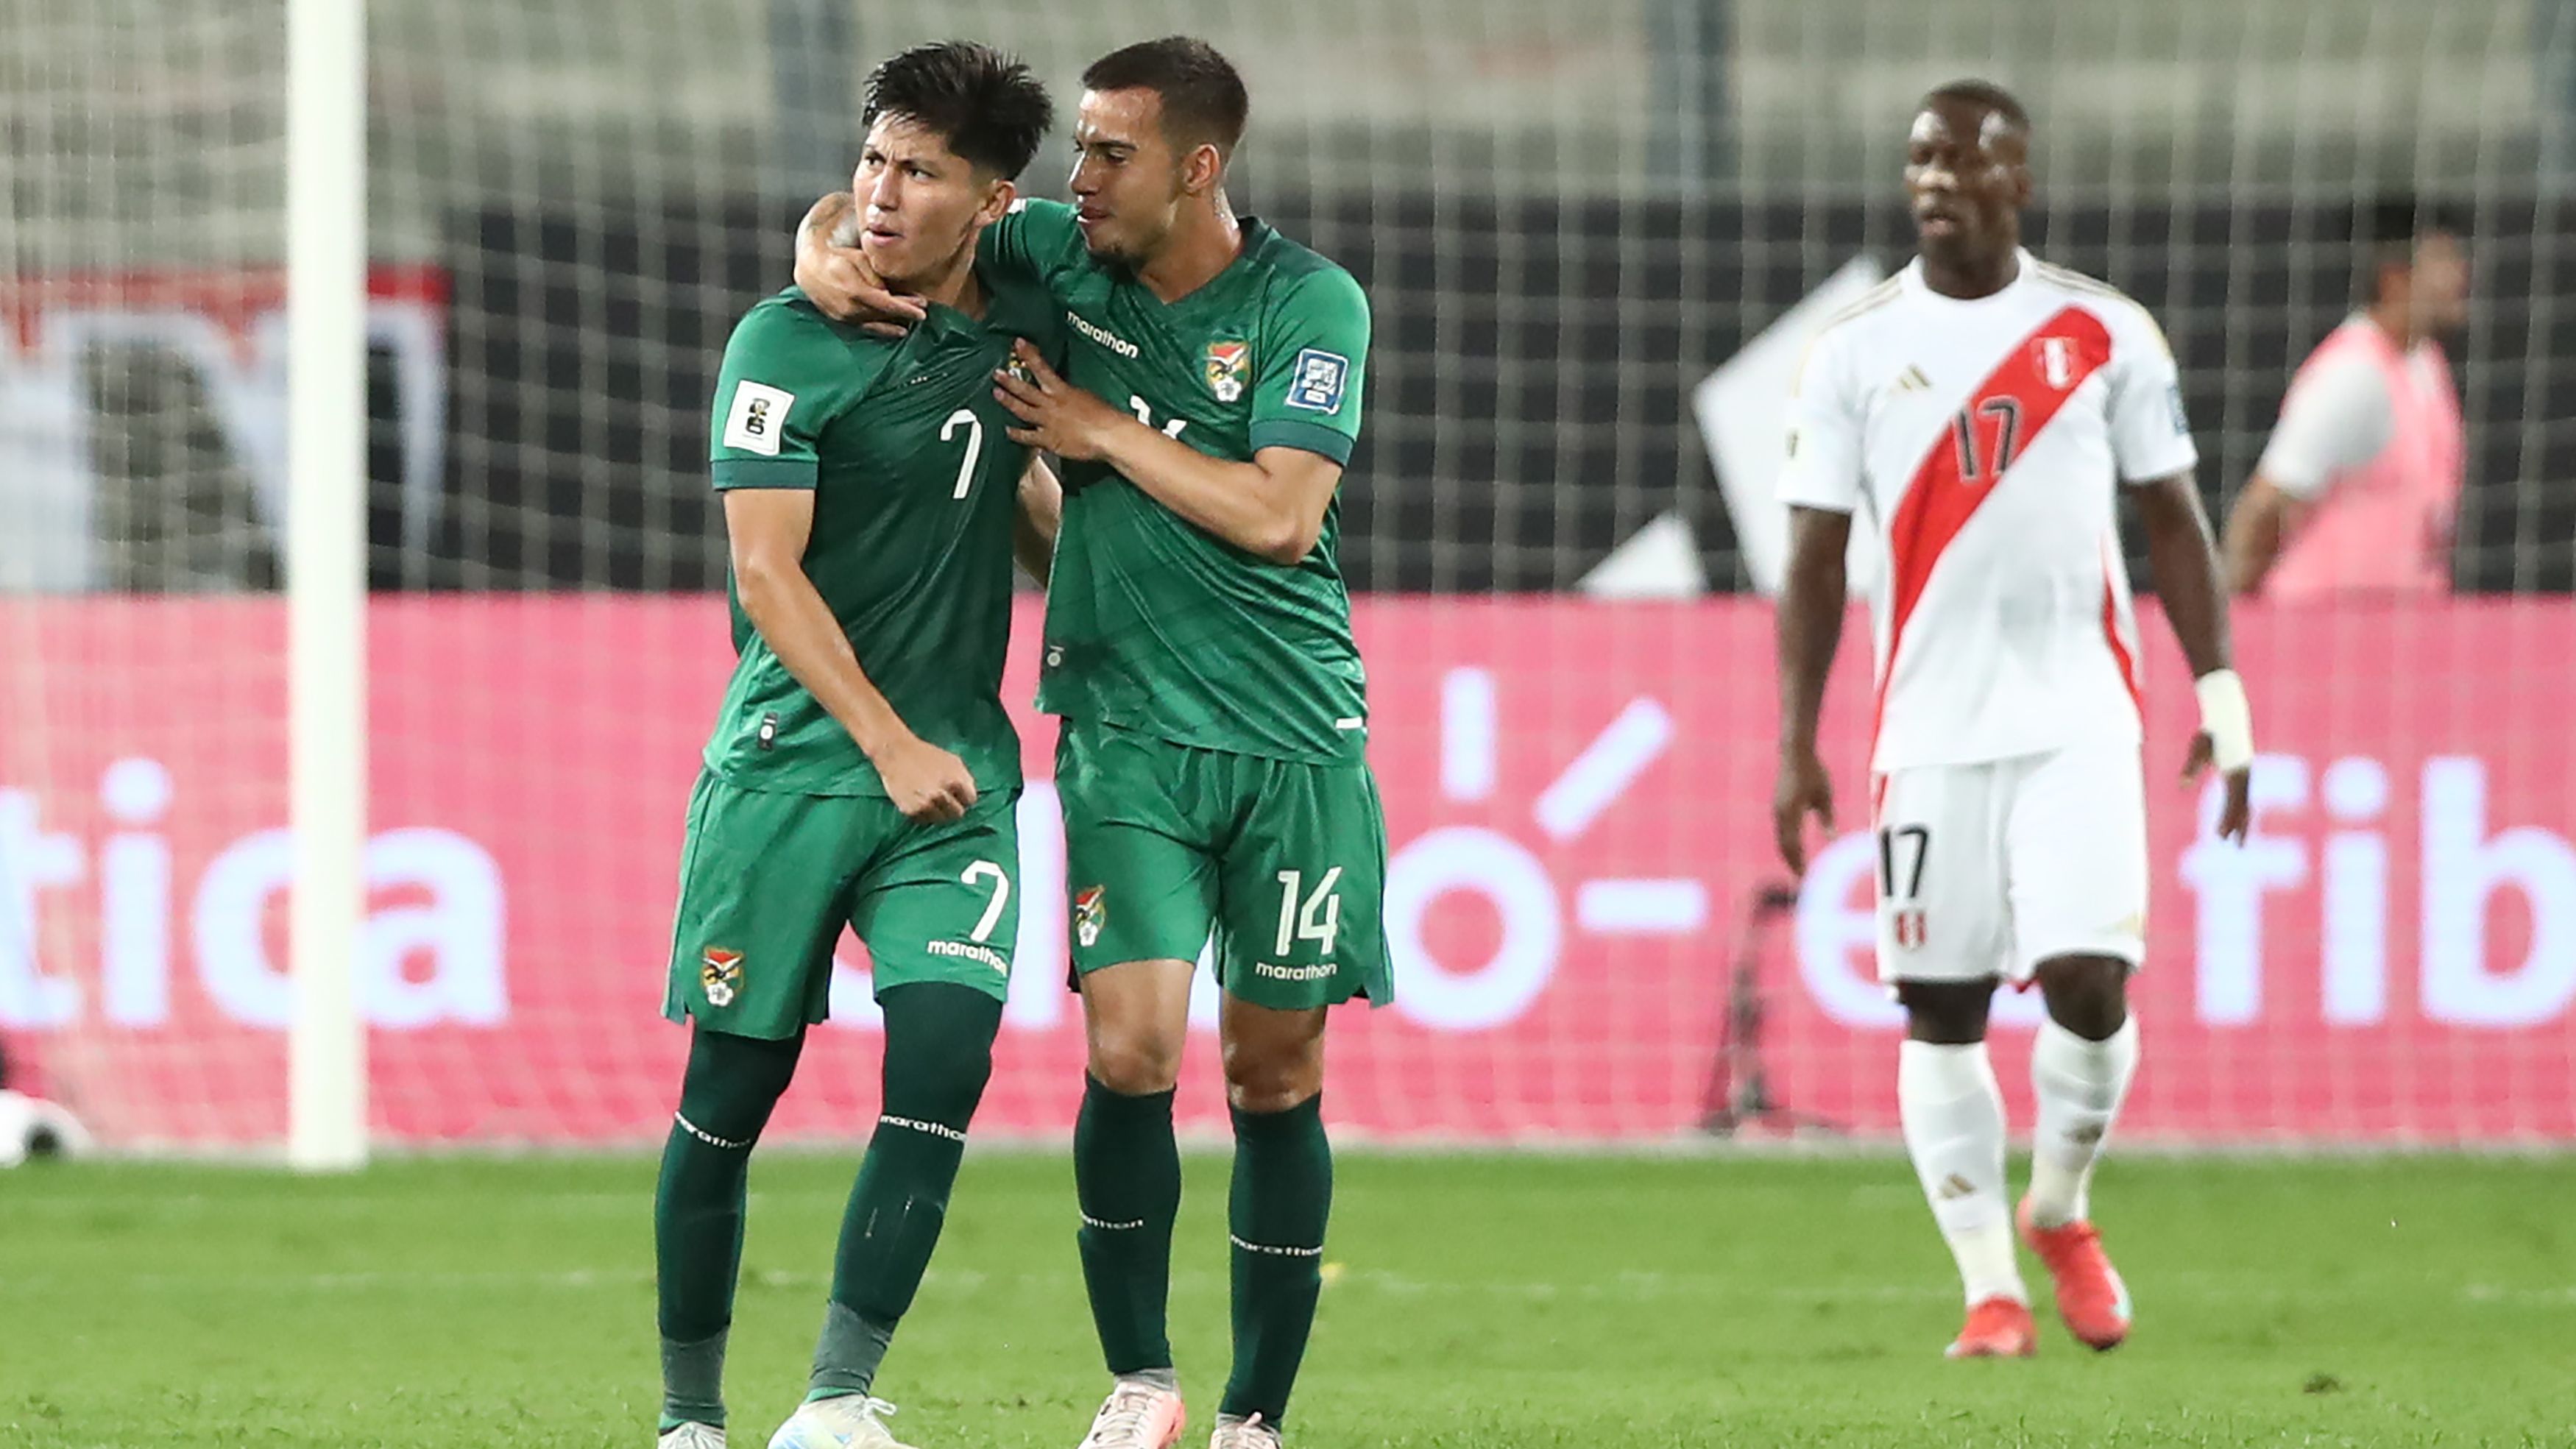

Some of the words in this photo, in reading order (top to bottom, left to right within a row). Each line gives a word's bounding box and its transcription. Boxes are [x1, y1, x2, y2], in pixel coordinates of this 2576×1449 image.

[1067, 311, 1139, 358] marathon
[941, 409, 982, 498] 7
[1952, 395, 2023, 483] 17
[961, 860, 1009, 943] 7
[1880, 823, 1929, 898] 17
[2177, 751, 2576, 1029] fib
[1275, 866, 1342, 957] 14
[1256, 962, 1337, 980] marathon
